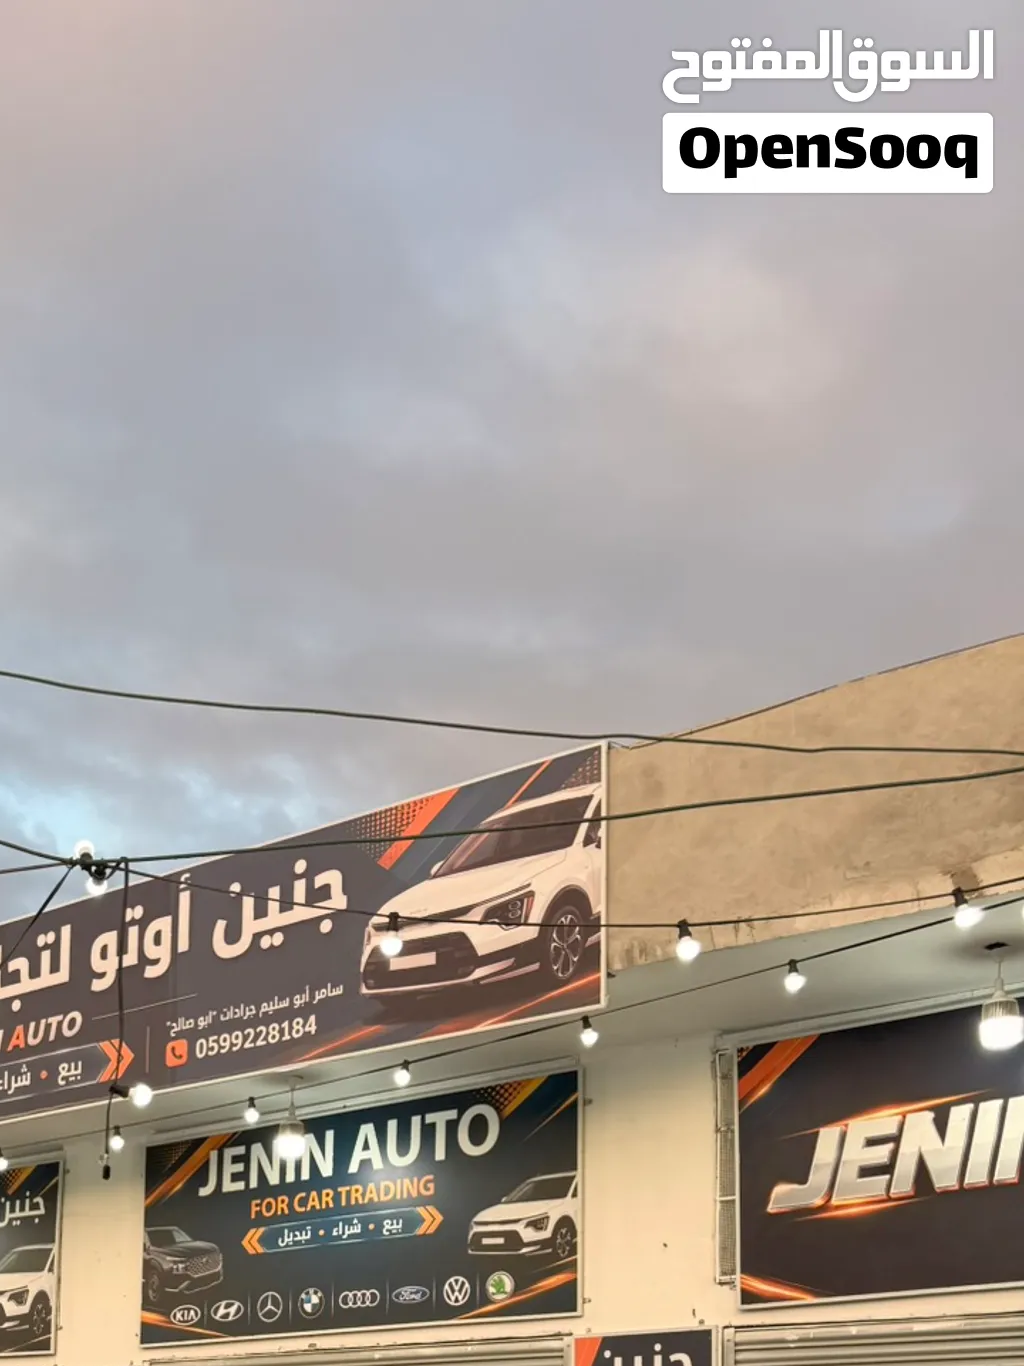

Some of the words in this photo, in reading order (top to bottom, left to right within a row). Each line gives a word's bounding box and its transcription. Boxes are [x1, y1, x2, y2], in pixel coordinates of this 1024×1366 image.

[213, 859, 347, 959] جنين
[90, 873, 192, 992] أوتو
[259, 996, 290, 1018] سليم
[313, 983, 344, 1004] سامر
[7, 1010, 83, 1051] AUTO
[195, 1014, 317, 1059] 0599228184
[57, 1060, 83, 1086] بيع
[197, 1129, 335, 1197] JENIN
[348, 1104, 501, 1174] AUTO
[250, 1195, 289, 1220] FOR
[293, 1188, 334, 1215] CAR
[337, 1175, 435, 1207] TRADING
[277, 1225, 312, 1248] تبديل
[331, 1217, 361, 1239] شراء
[382, 1218, 403, 1235] بيع
